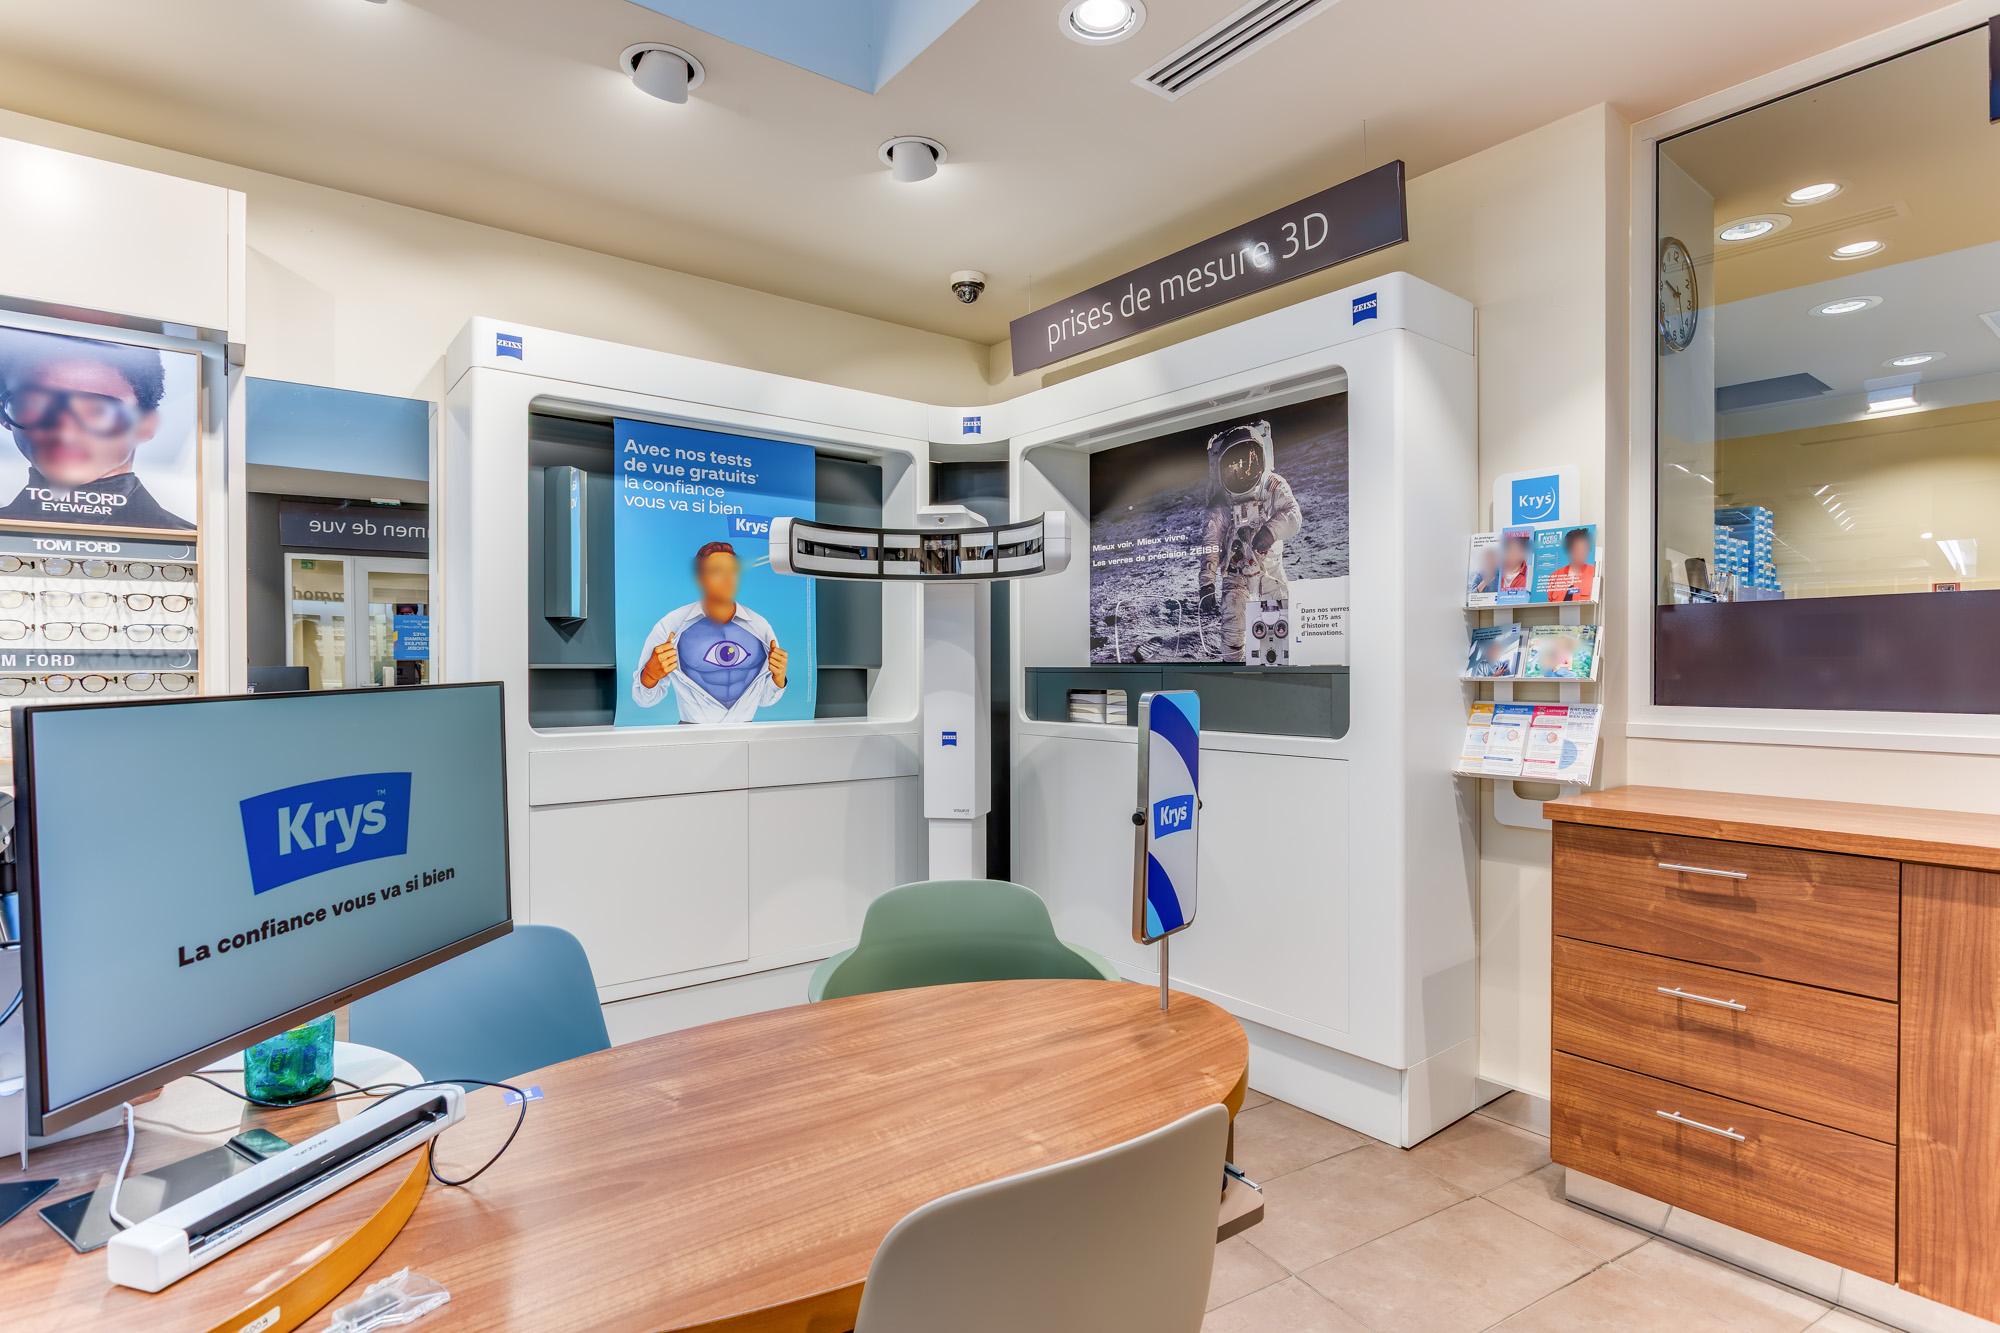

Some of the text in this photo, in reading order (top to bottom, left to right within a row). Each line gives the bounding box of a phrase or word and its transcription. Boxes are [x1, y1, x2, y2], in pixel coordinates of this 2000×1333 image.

[1048, 213, 1329, 352] prises de mesure 3D
[1353, 300, 1377, 313] ZEISS
[496, 339, 522, 349] ZEISS
[623, 439, 752, 468] Avec nos tests
[623, 458, 647, 472] de
[652, 464, 685, 476] vue
[624, 475, 725, 498] la confiance
[74, 491, 128, 507] FORD
[623, 495, 743, 515] vous va si bien
[1519, 495, 1552, 509] Krys
[42, 502, 113, 516] EYEWEAR
[735, 519, 768, 535] Krys
[32, 539, 121, 553] TOM FORD
[1092, 544, 1115, 552] Mieux
[1137, 538, 1162, 546] Mieux
[1108, 557, 1134, 566] verres
[1148, 551, 1187, 561] précision
[1189, 546, 1223, 556] ZEISS.
[26, 655, 75, 668] FORD
[1160, 805, 1187, 828] Krys
[278, 800, 387, 856] Krys
[178, 867, 455, 967] La confiance vous va si bien
